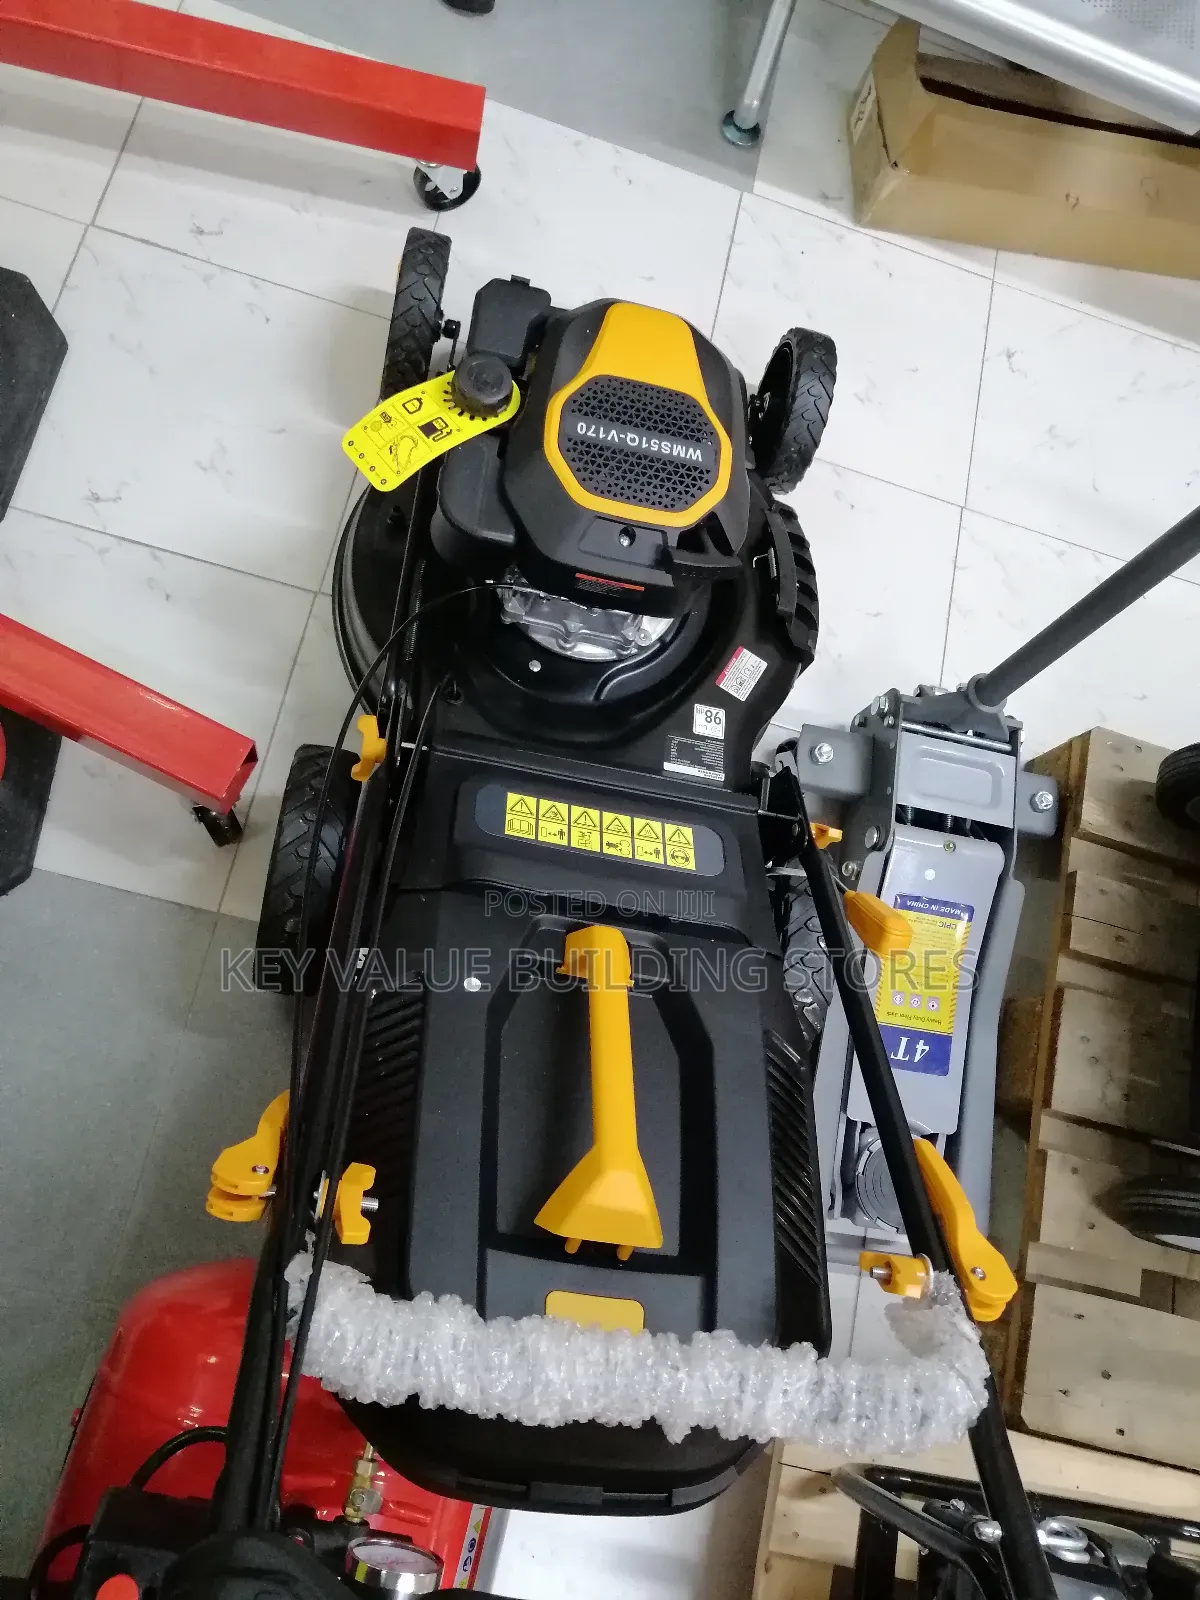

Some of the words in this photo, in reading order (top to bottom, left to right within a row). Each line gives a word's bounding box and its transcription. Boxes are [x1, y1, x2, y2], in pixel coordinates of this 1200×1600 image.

[577, 422, 702, 462] WMS51Q-V170
[705, 709, 722, 725] 98
[906, 900, 929, 909] CHINA
[930, 904, 939, 912] IN
[940, 906, 962, 915] MADE
[938, 921, 957, 930] CPIC
[926, 1016, 942, 1026] Heavy
[890, 1036, 930, 1063] 4T
